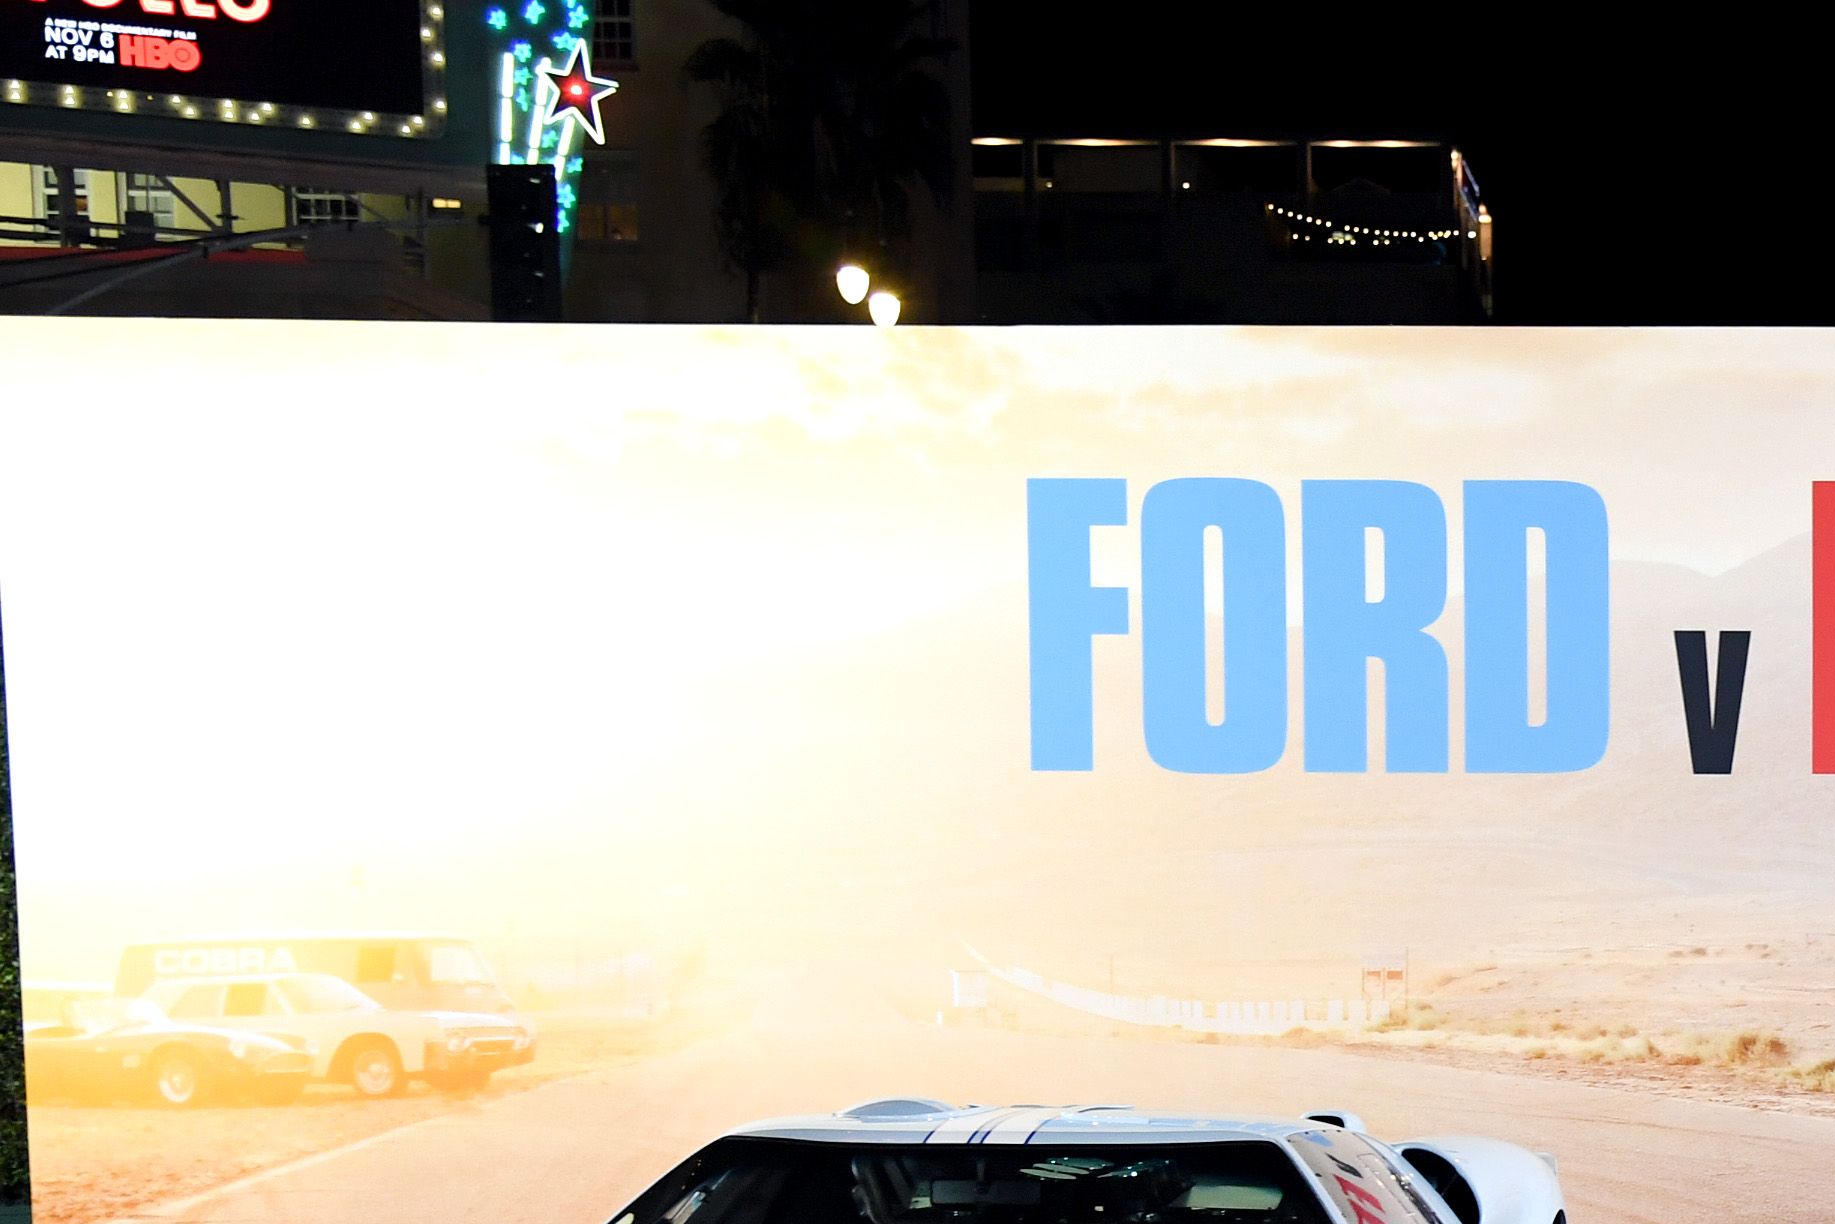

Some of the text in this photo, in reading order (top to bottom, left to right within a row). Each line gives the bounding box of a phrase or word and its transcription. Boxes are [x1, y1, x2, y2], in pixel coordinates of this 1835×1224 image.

[44, 18, 54, 26] A
[44, 26, 115, 48] NOV 6
[45, 45, 115, 64] AT 9PM
[119, 34, 202, 72] HBO
[1026, 477, 1610, 773] FORD
[154, 949, 297, 974] COBRA
